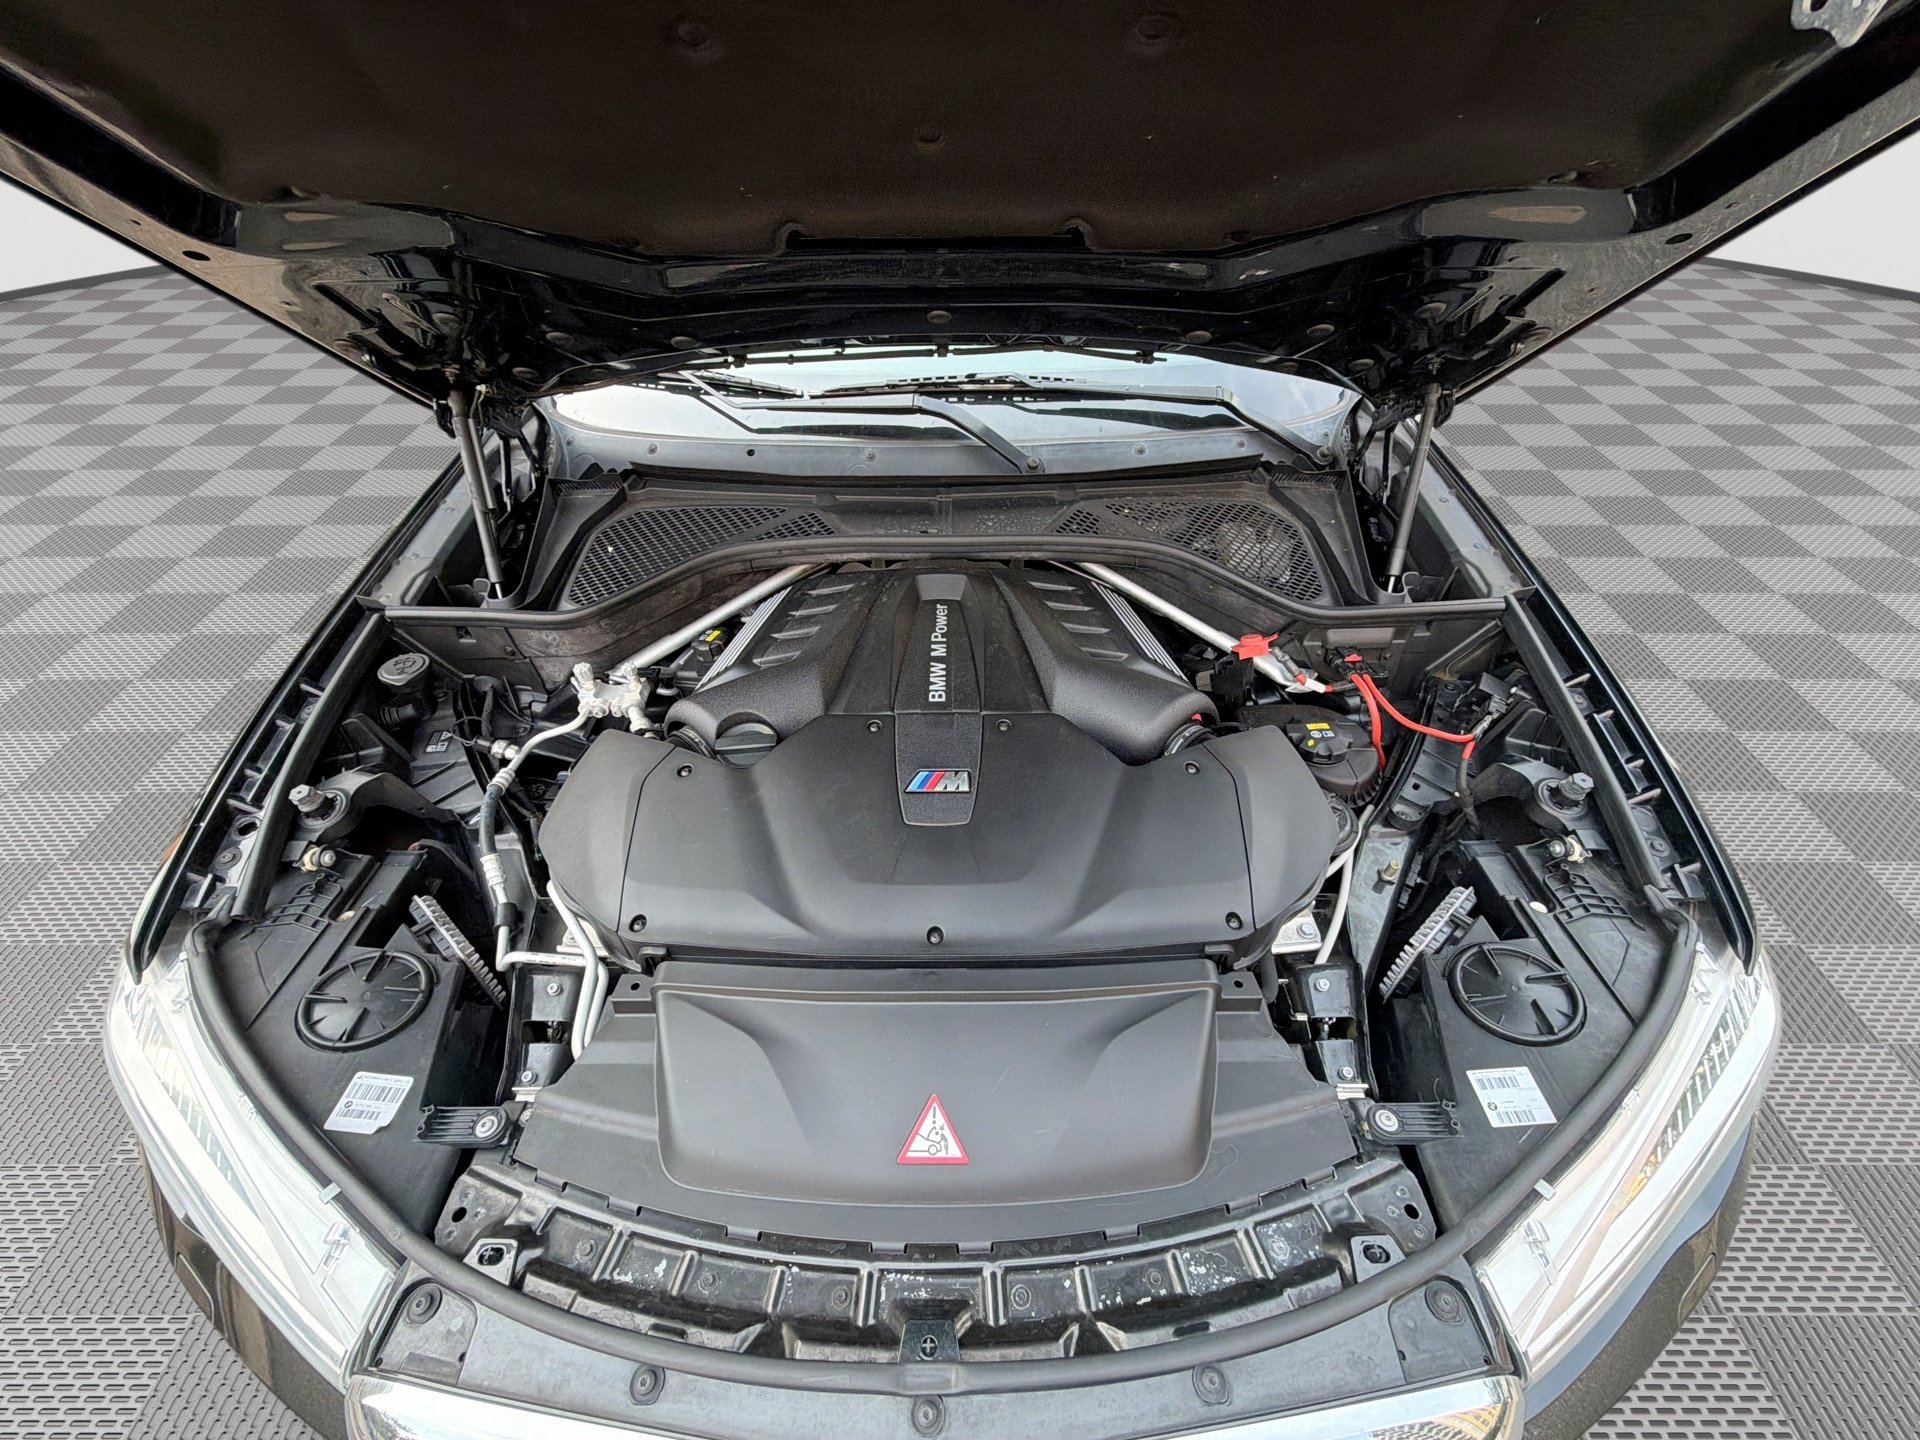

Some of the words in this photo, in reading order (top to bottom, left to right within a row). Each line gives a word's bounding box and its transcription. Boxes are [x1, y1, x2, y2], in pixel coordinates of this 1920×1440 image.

[931, 603, 948, 642] Power
[930, 644, 947, 657] M
[928, 662, 946, 702] BMW
[933, 771, 970, 792] M
